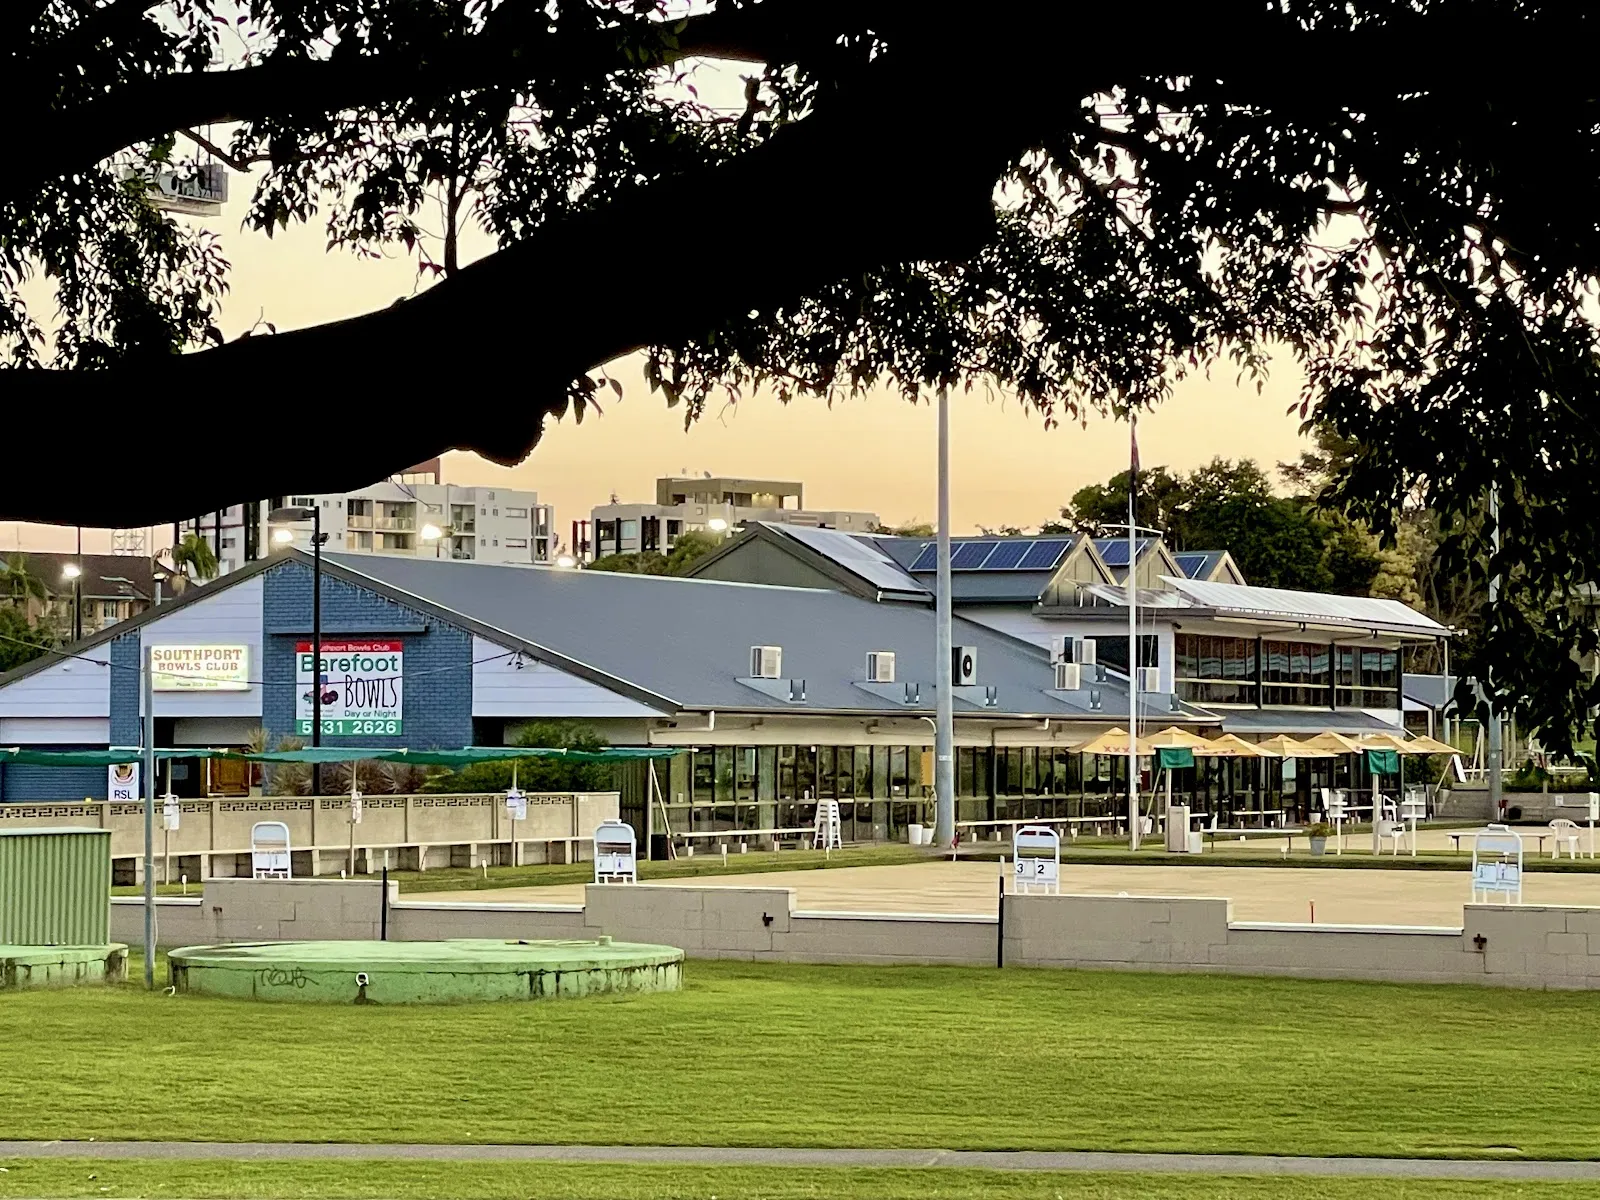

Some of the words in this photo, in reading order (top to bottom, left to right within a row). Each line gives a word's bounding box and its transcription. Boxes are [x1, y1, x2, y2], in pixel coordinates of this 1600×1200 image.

[347, 644, 371, 652] Bowls
[373, 644, 390, 652] Club
[153, 649, 242, 661] SOUTHPORT
[158, 662, 201, 671] BOWLS
[206, 662, 238, 671] CLUB
[301, 653, 398, 672] Barefoot
[345, 674, 397, 708] BOWLS
[344, 709, 360, 718] Day
[374, 709, 397, 718] Night
[352, 720, 397, 734] 2626
[114, 789, 132, 800] RSL
[1017, 863, 1024, 873] 3
[1037, 864, 1045, 874] 2
